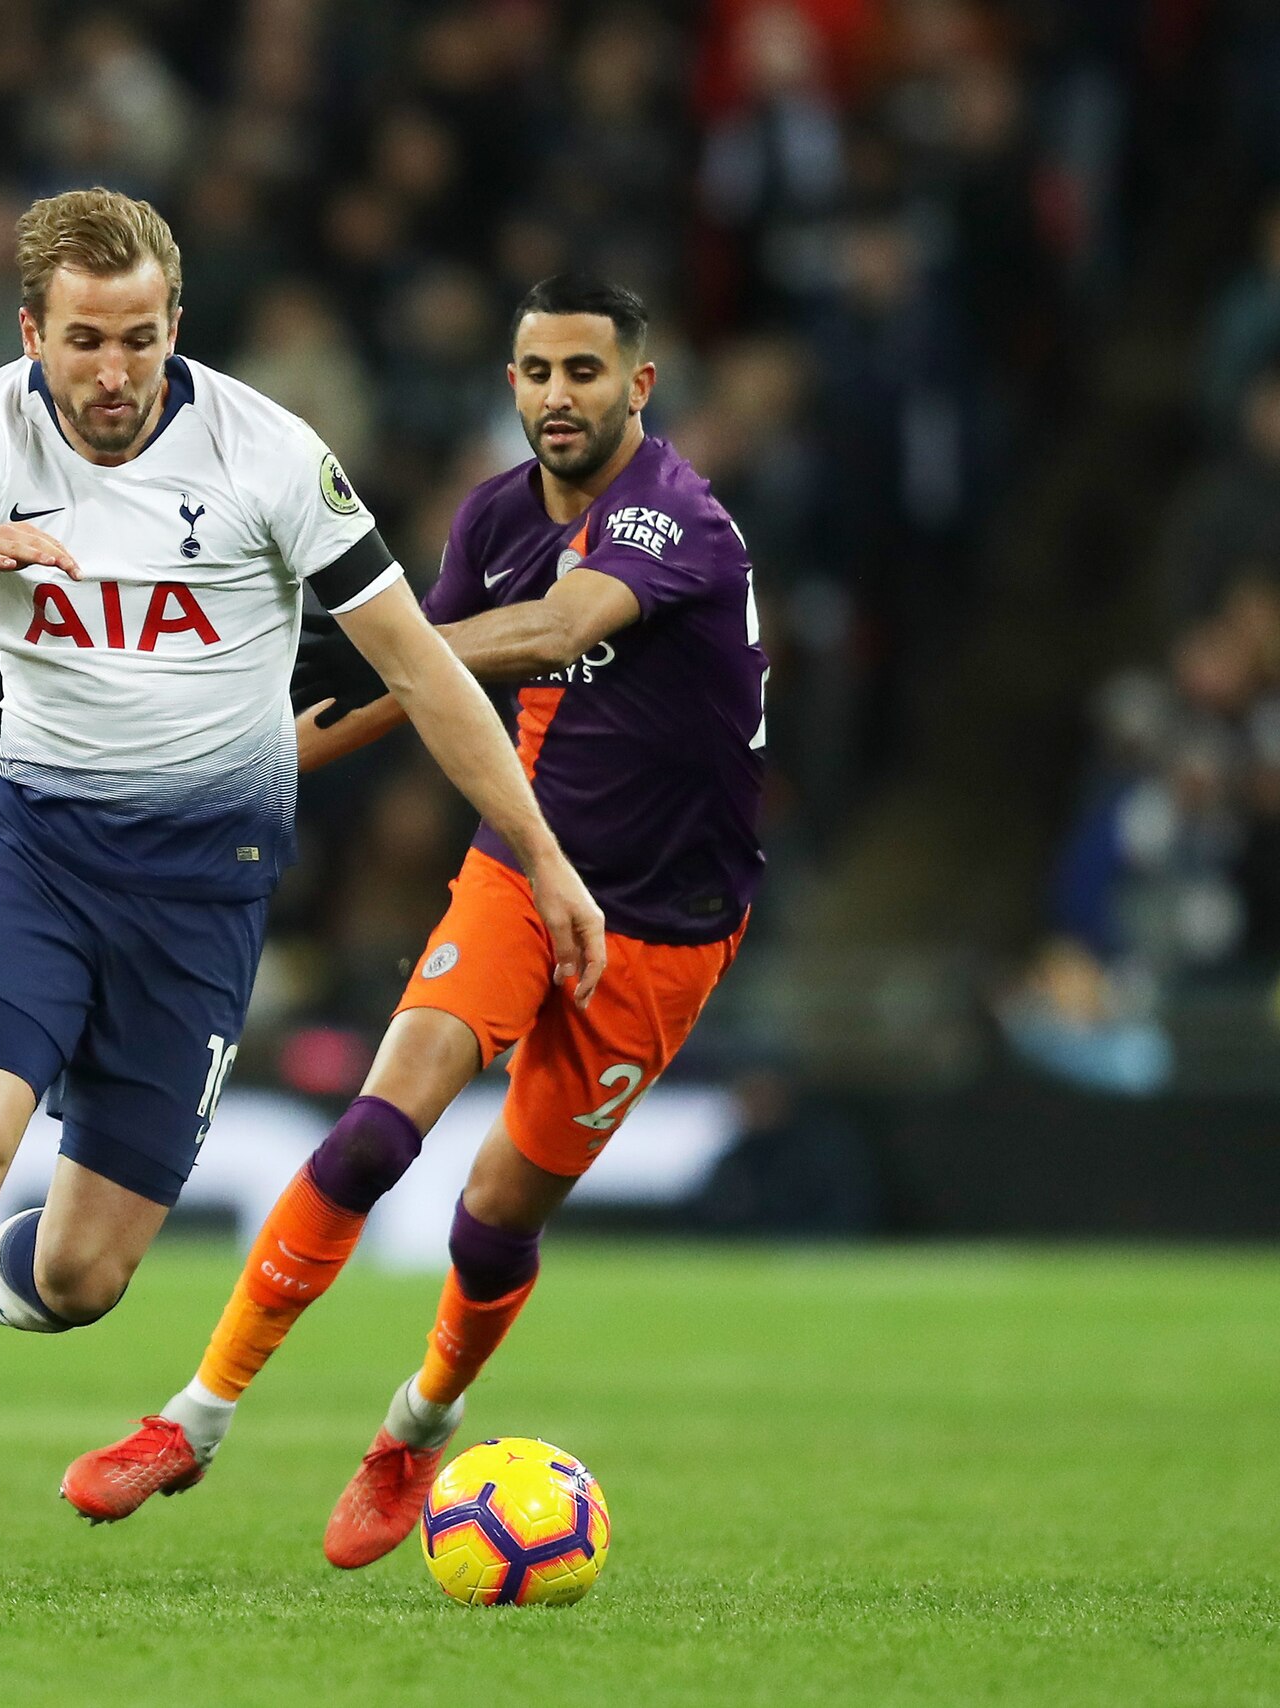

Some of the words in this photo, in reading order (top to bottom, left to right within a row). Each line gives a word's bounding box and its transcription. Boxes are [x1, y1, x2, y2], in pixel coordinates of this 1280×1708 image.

[606, 507, 684, 546] NEXEN
[612, 522, 667, 555] TIRE
[24, 581, 222, 651] AIA
[260, 1260, 311, 1291] CITY
